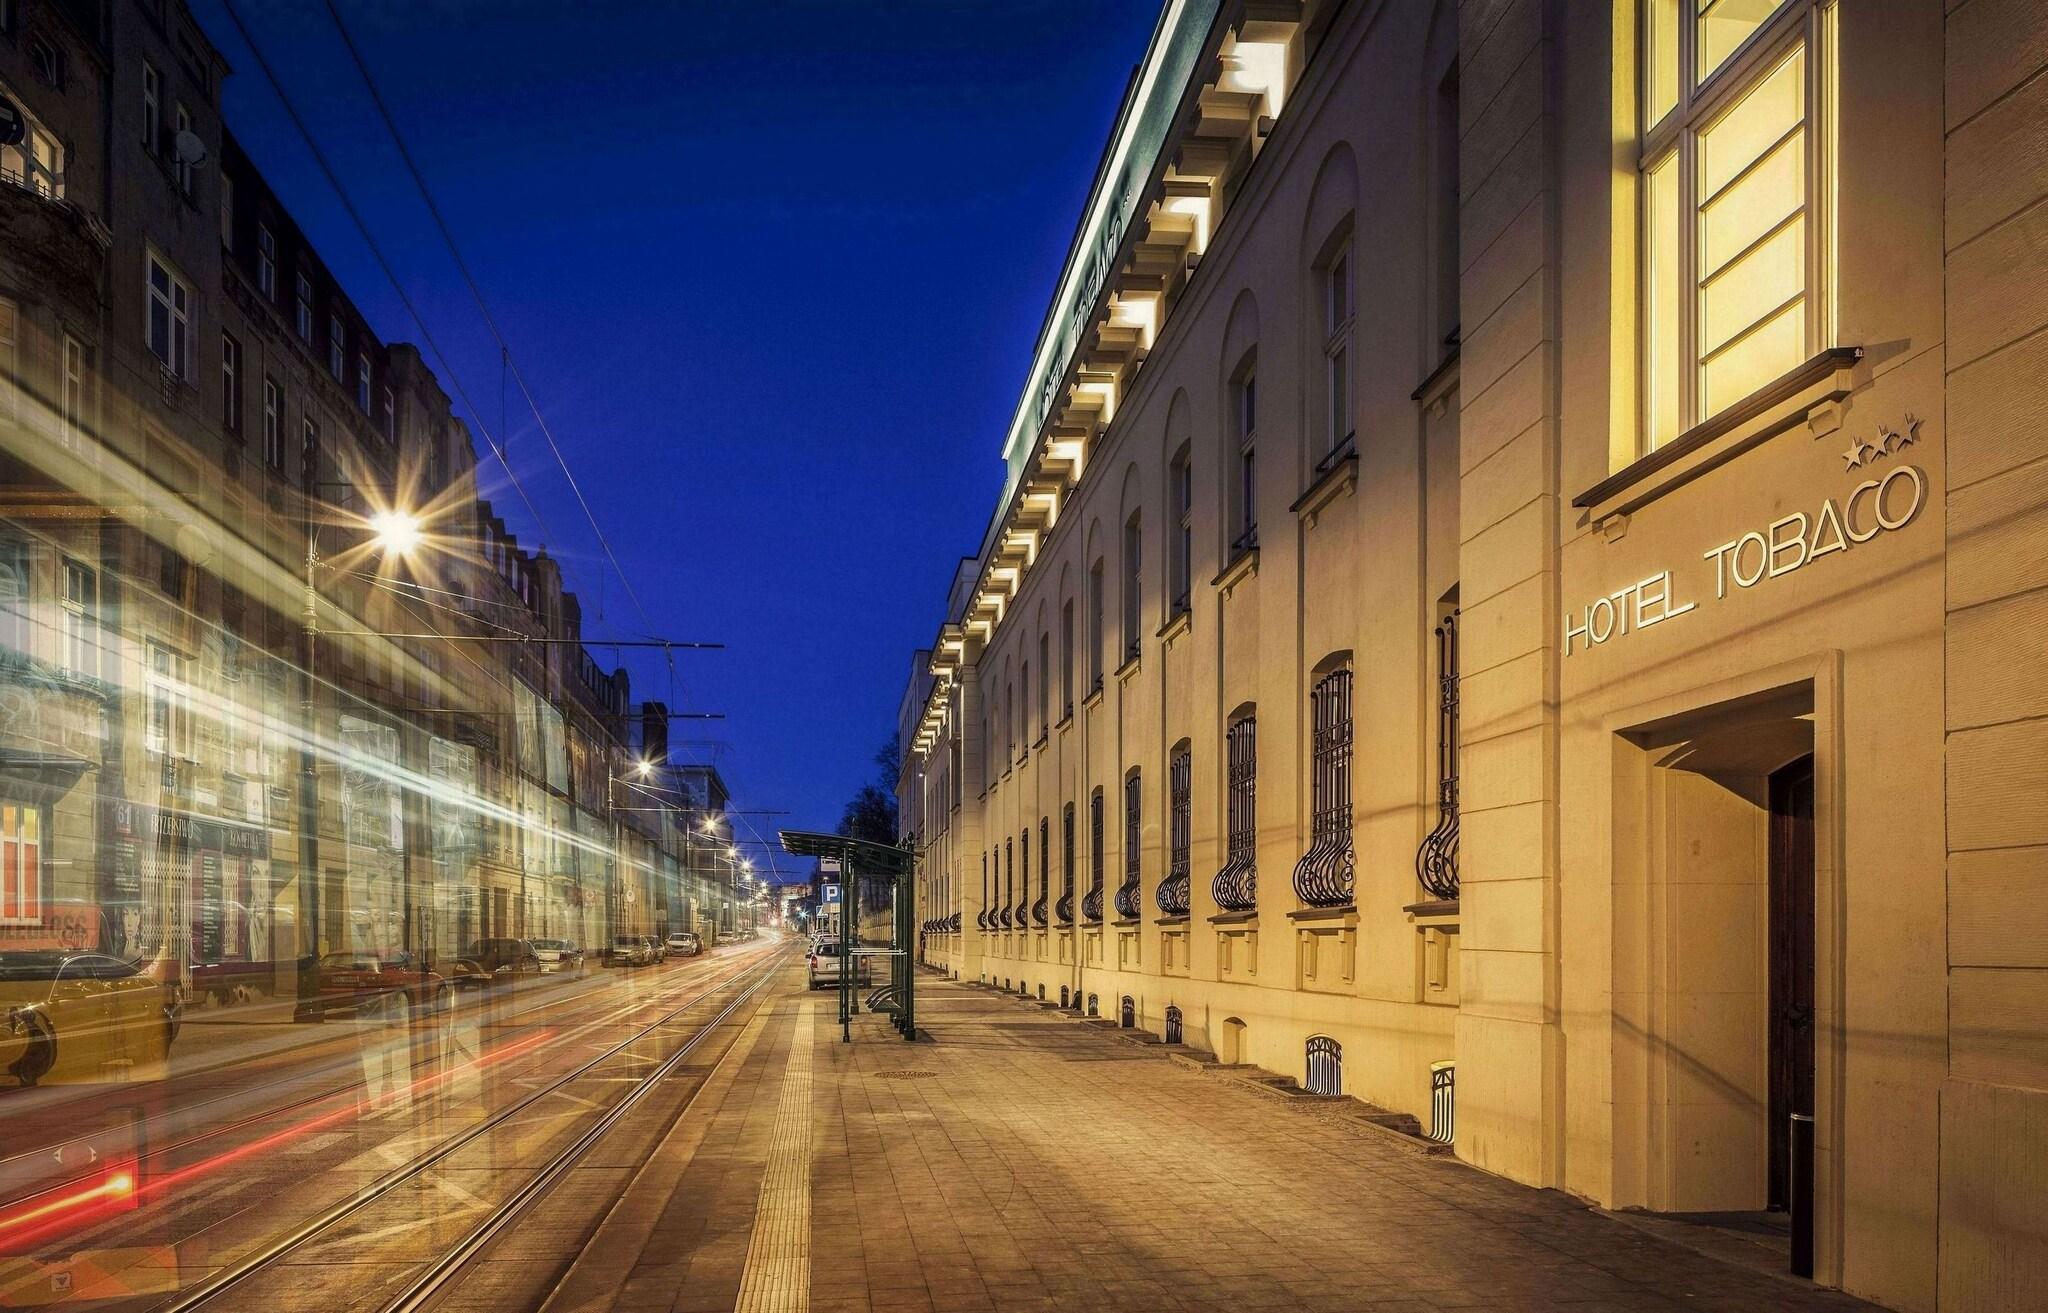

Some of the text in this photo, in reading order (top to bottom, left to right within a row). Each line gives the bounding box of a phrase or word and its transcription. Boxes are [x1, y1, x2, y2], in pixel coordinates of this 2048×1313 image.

[1565, 465, 1922, 656] HOTEL TOBACO
[826, 886, 838, 902] P
